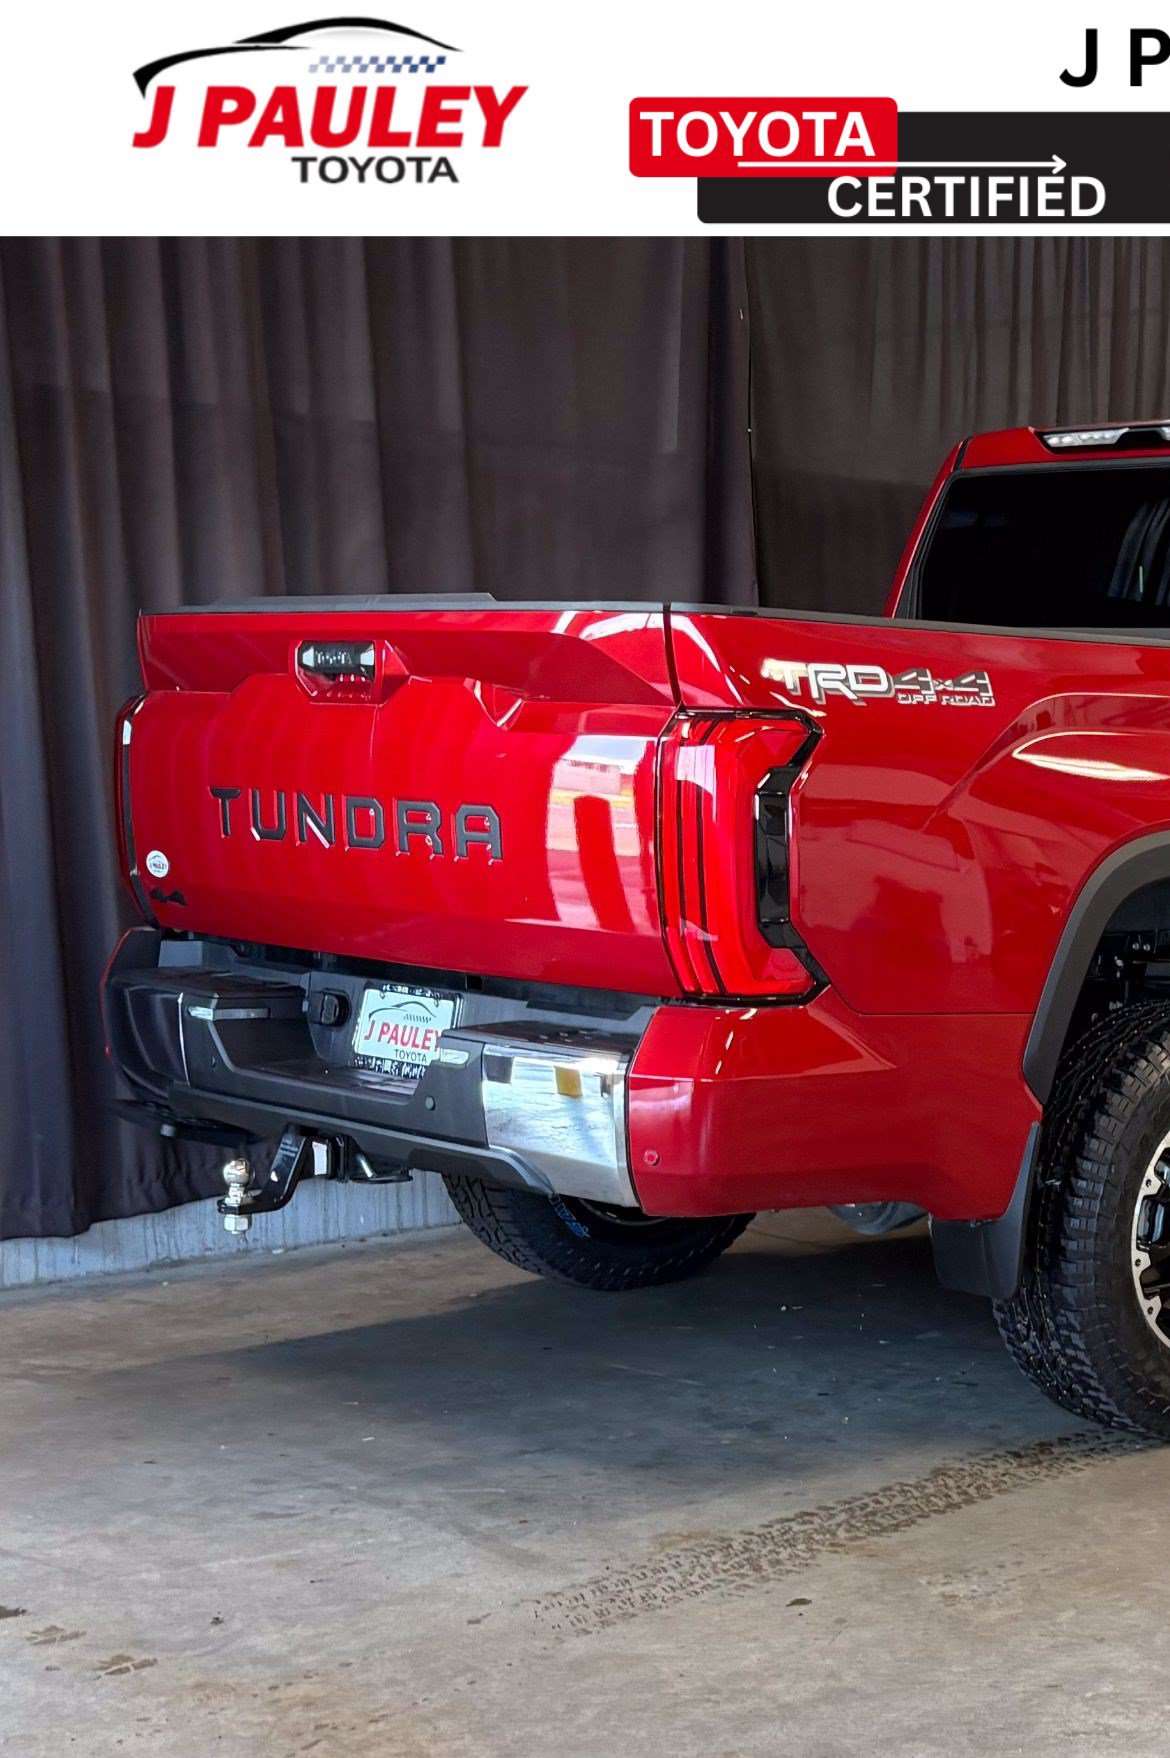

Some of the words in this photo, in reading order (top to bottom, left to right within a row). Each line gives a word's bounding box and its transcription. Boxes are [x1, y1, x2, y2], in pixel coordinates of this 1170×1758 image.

[761, 658, 894, 706] TRD
[207, 786, 505, 866] TUNDRA
[364, 1019, 376, 1041] J
[394, 1048, 428, 1064] TOYOTA
